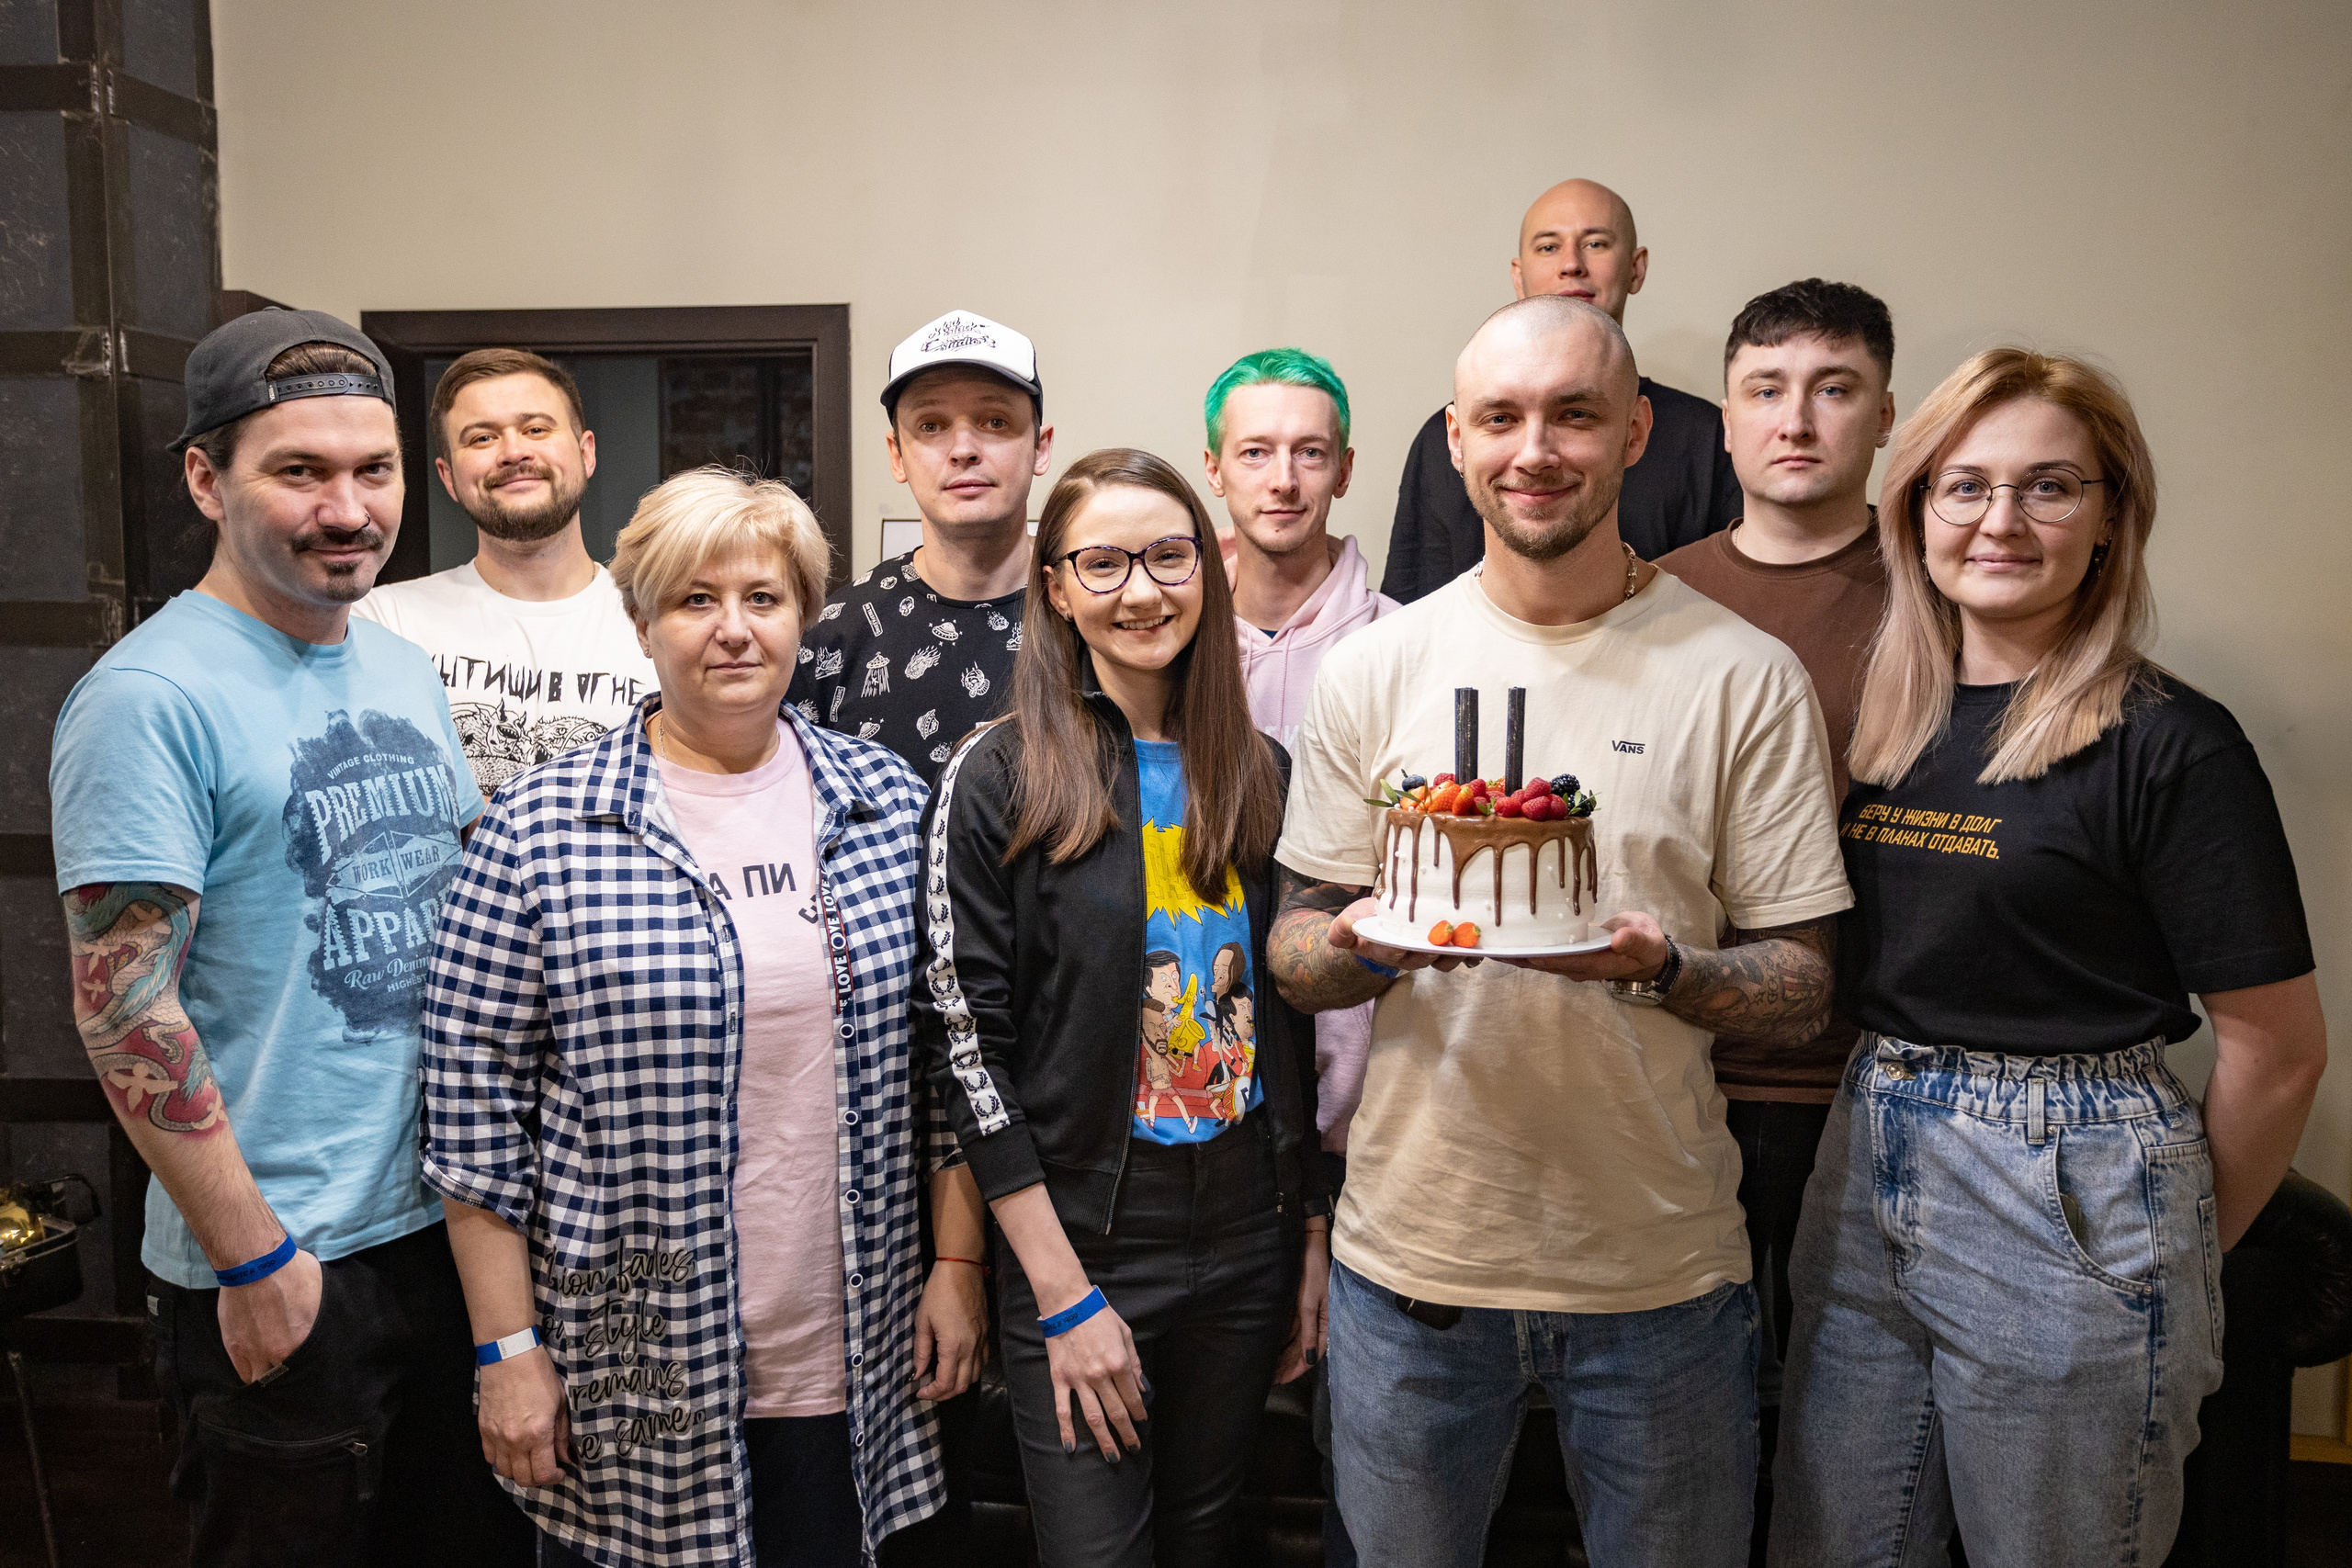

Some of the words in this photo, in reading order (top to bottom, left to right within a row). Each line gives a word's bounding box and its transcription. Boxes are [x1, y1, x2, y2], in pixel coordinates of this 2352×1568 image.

[431, 653, 543, 704] ЫТИЩИ
[327, 756, 361, 780] VINTAGE
[363, 753, 415, 765] CLOTHING
[1611, 739, 1645, 755] VANS
[305, 763, 459, 865] PREMIUM
[1859, 804, 1892, 822] БЕРУ
[1890, 807, 1904, 823] У
[1901, 809, 1951, 829] ЖИЗНИ
[1950, 814, 1962, 830] В
[1959, 815, 2003, 834] ДОЛГ
[1848, 823, 1868, 840] НЕ
[1864, 826, 1878, 841] В
[1875, 828, 1929, 849] ПЛАНАХ
[1928, 833, 2001, 860] ОТДАВАТЬ.
[352, 857, 391, 885] WORK
[400, 845, 441, 871] WEAR
[344, 965, 385, 990] Raw
[834, 954, 852, 994] LOVE
[584, 1289, 668, 1365] style
[572, 1360, 686, 1412] remains
